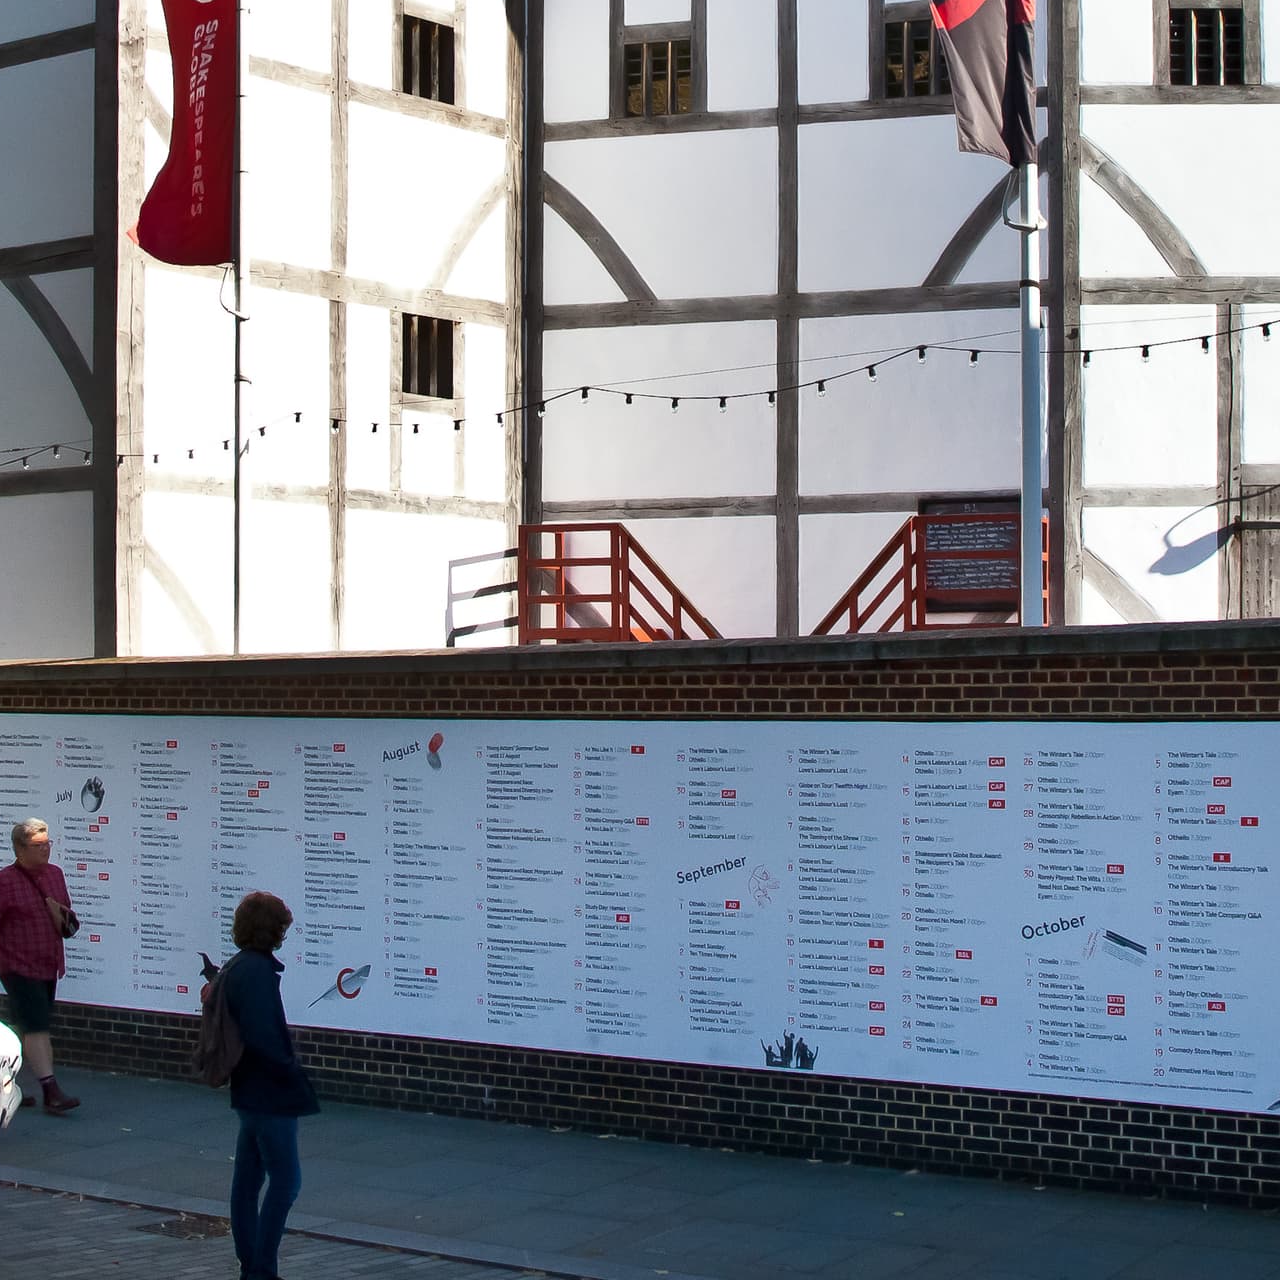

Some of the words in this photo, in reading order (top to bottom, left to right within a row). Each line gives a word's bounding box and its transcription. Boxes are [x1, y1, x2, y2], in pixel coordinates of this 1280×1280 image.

[189, 23, 206, 108] GLOBE
[190, 19, 219, 218] SHAKESPEARE'S
[383, 741, 421, 762] August
[55, 789, 73, 804] July
[676, 856, 747, 884] September
[1021, 915, 1086, 940] October
